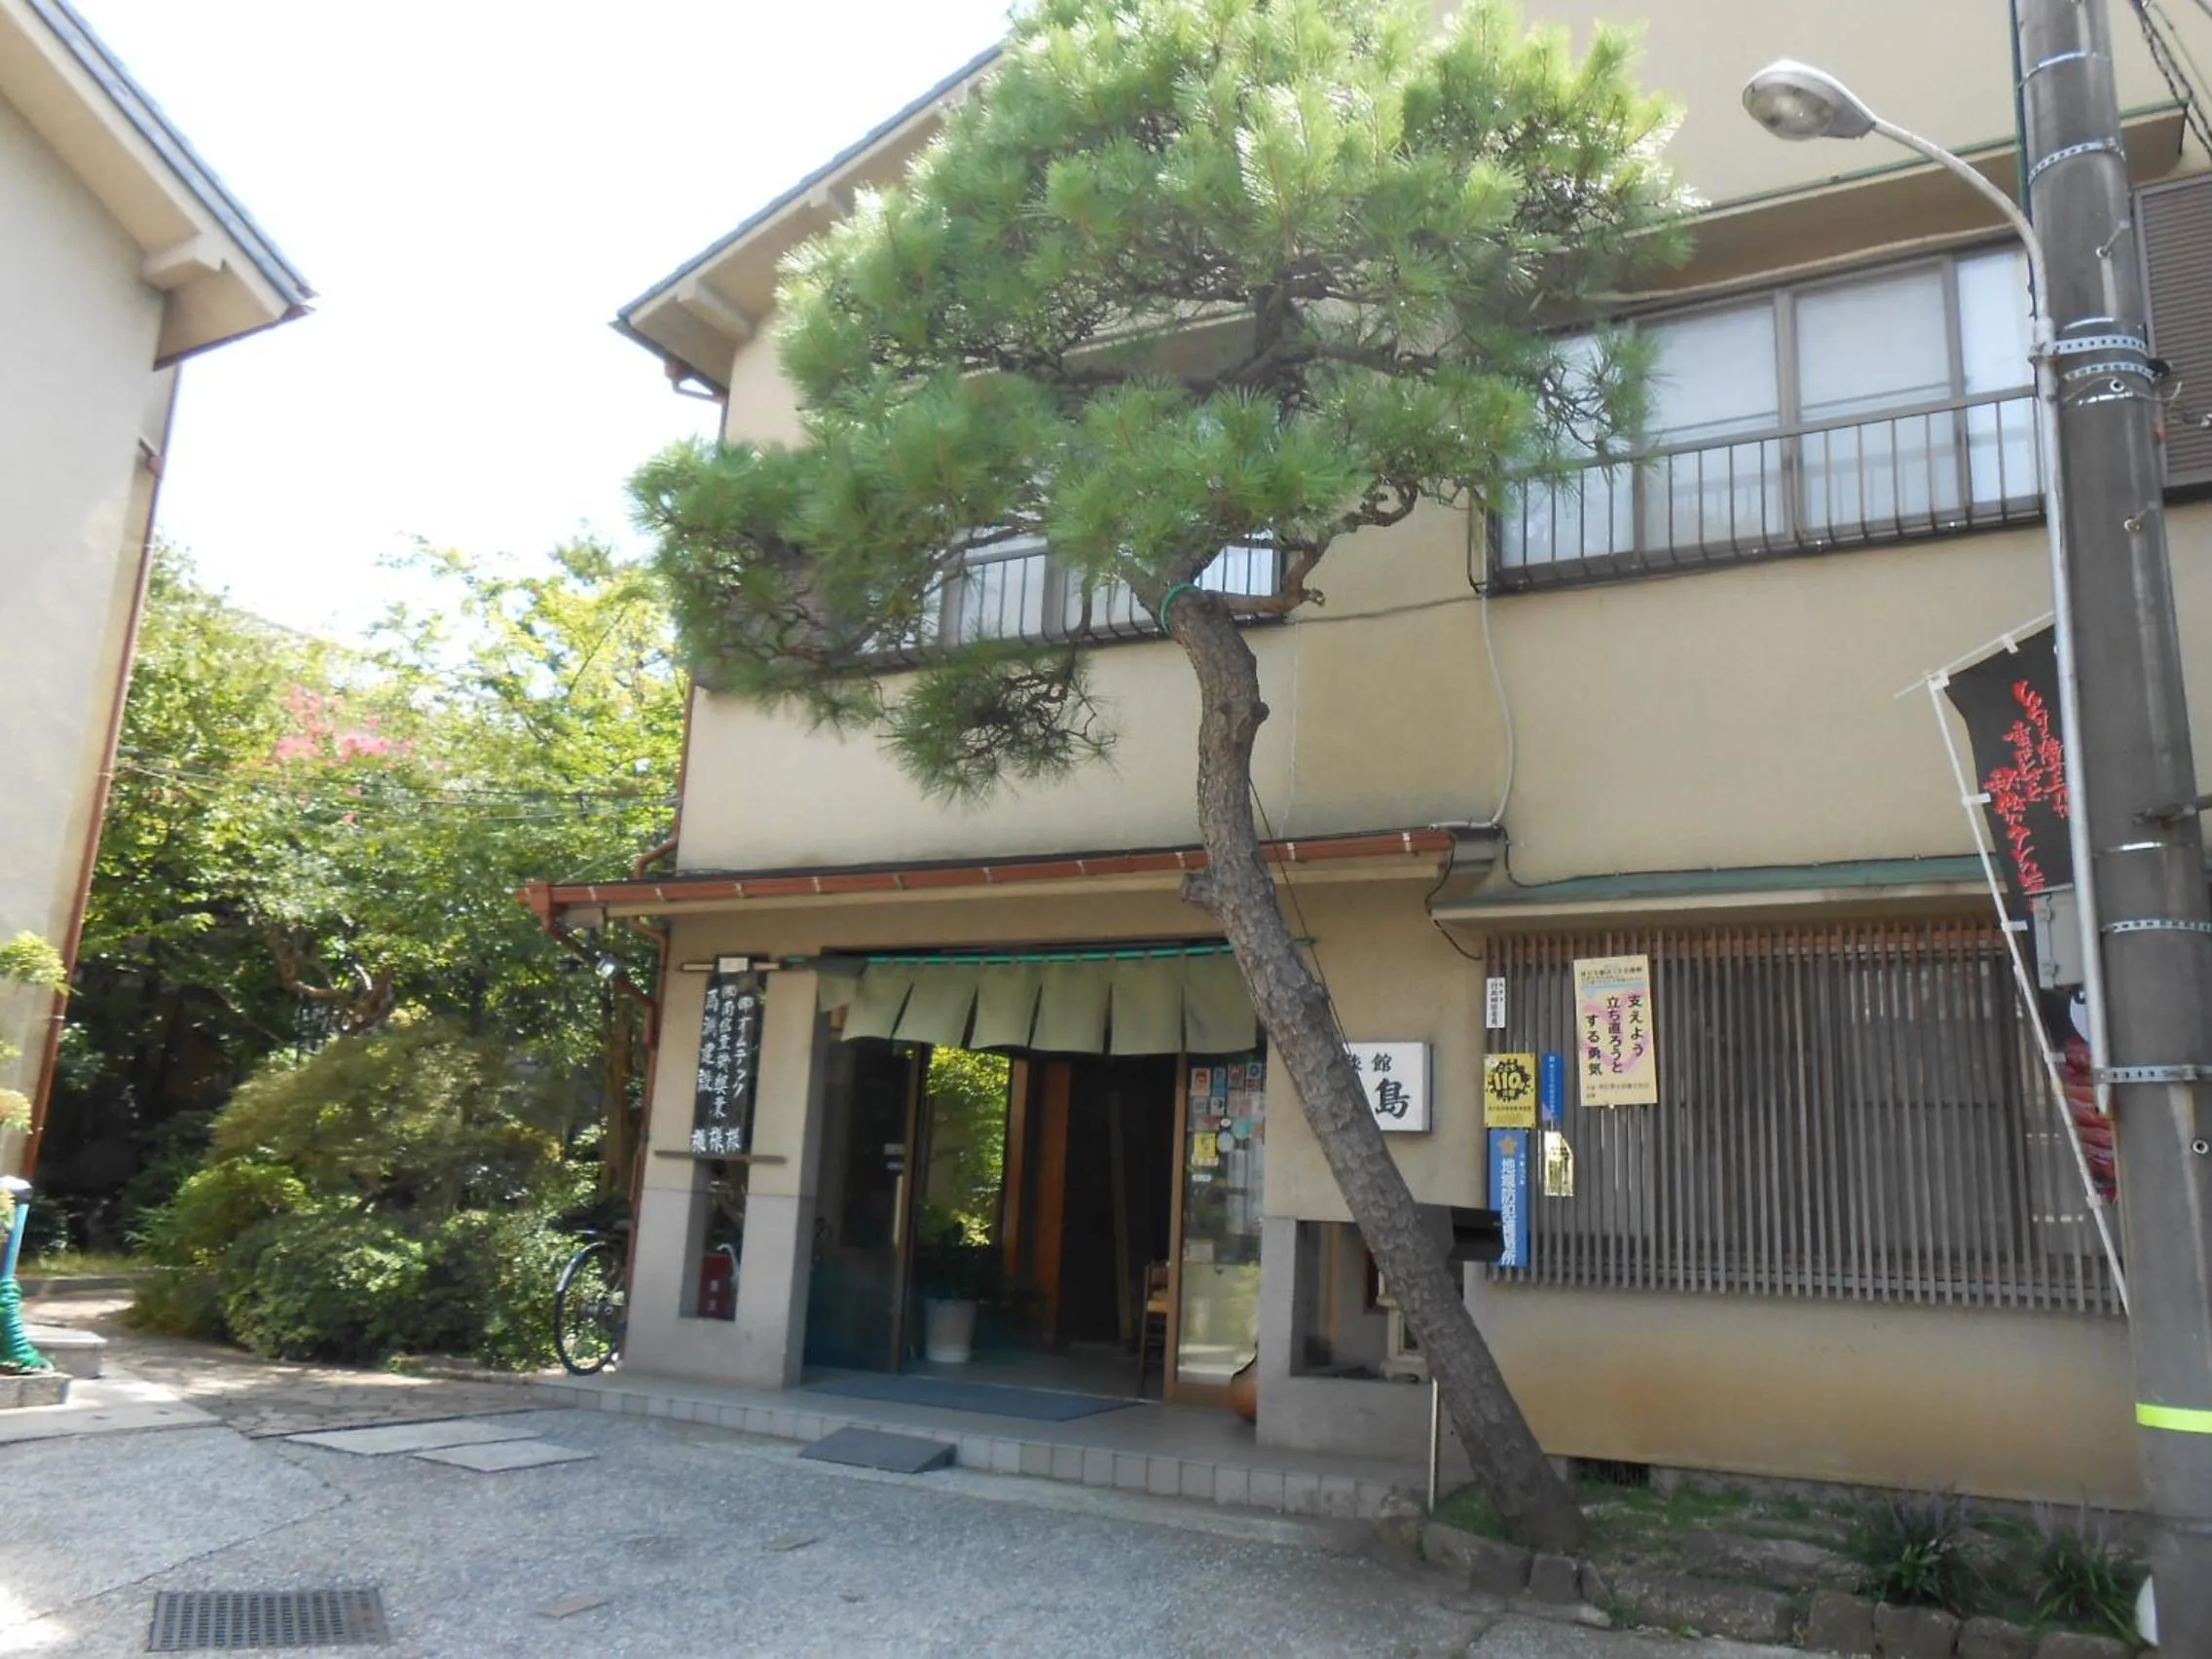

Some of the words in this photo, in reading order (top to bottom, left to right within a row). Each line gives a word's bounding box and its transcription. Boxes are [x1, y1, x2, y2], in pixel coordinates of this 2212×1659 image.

[1585, 1014, 1603, 1076] する勇気
[1606, 996, 1623, 1073] 立ち直ろうと
[1628, 993, 1644, 1056] 支えよう
